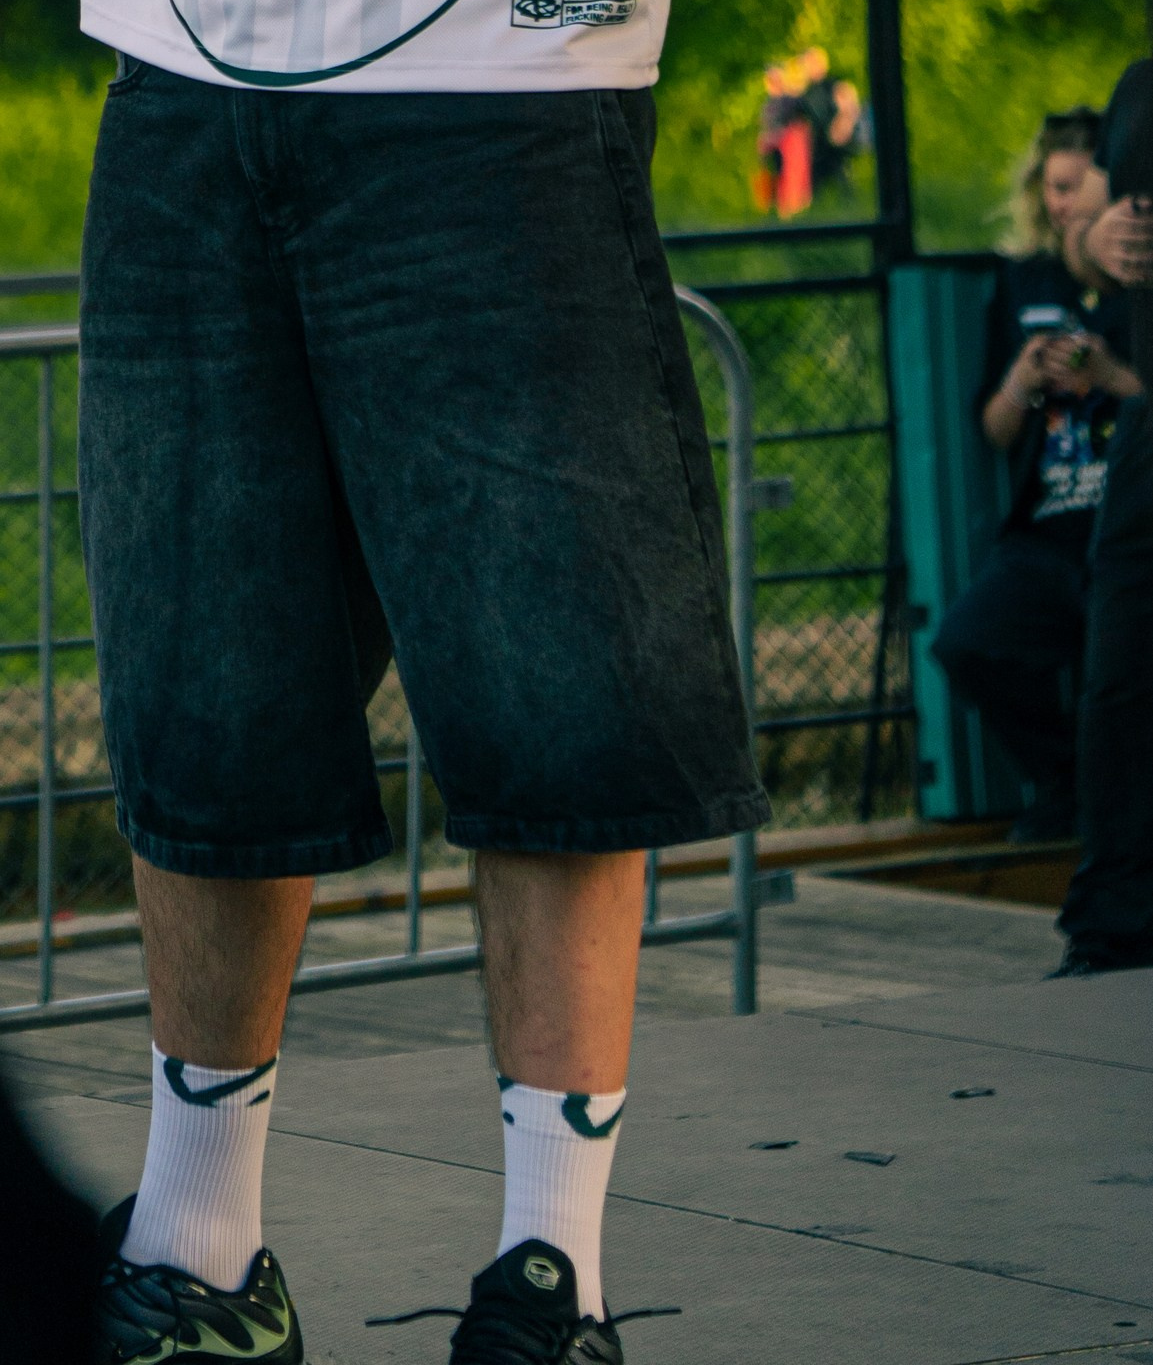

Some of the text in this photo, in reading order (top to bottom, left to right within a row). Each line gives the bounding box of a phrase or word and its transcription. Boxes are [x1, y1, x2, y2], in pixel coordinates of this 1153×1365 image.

[566, 5, 583, 15] FOR
[586, 3, 614, 13] BEING
[565, 13, 605, 23] FUCKING
